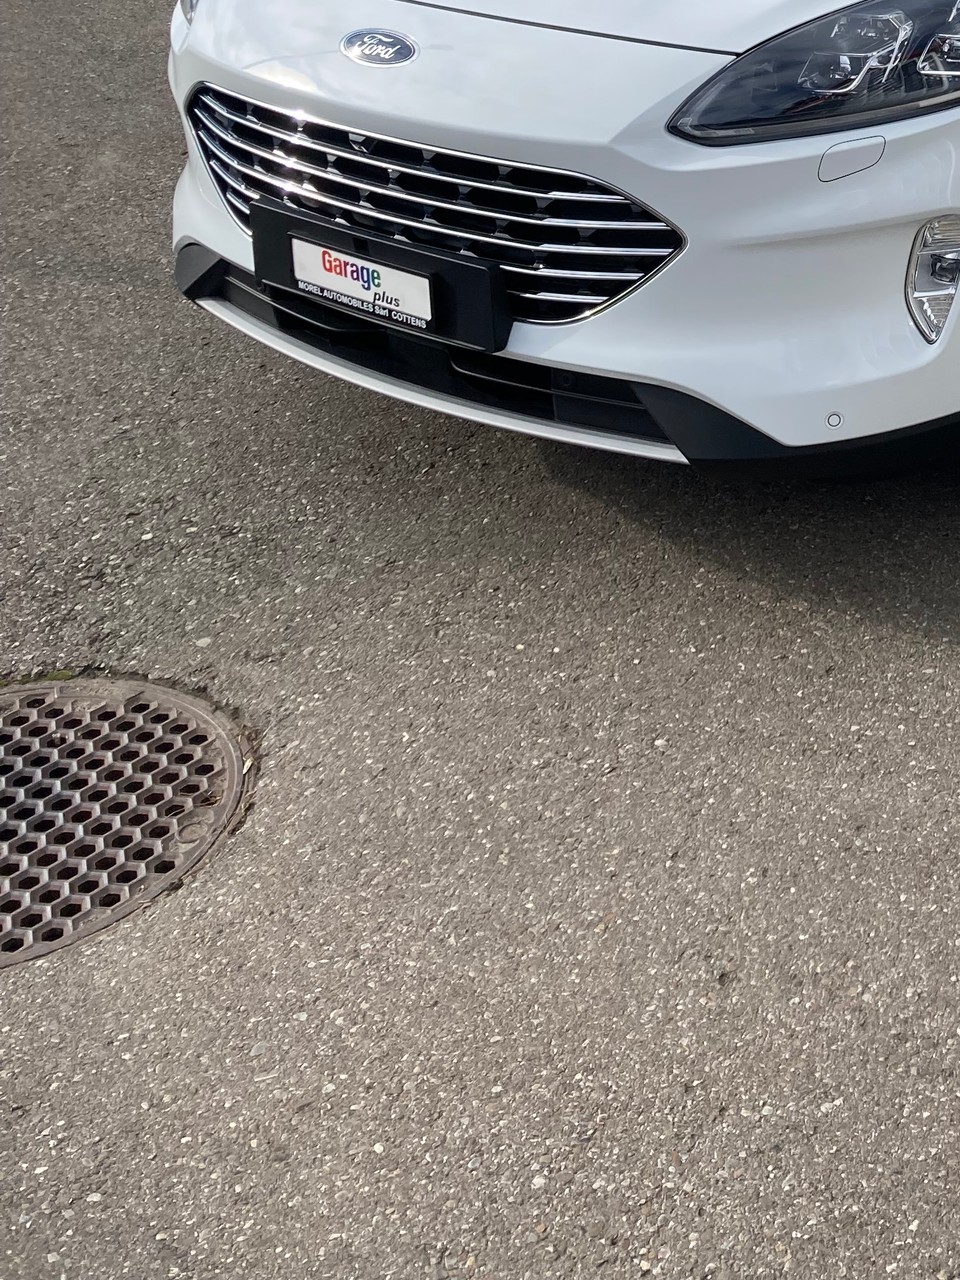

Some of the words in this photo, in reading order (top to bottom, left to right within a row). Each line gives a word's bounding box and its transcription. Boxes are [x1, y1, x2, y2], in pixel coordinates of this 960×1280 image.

[354, 34, 401, 59] Ford
[321, 250, 381, 291] Garage
[298, 281, 322, 296] MOREL
[323, 289, 373, 312] AUTOMOBILES
[391, 311, 427, 329] COTTENS
[373, 291, 400, 308] plus
